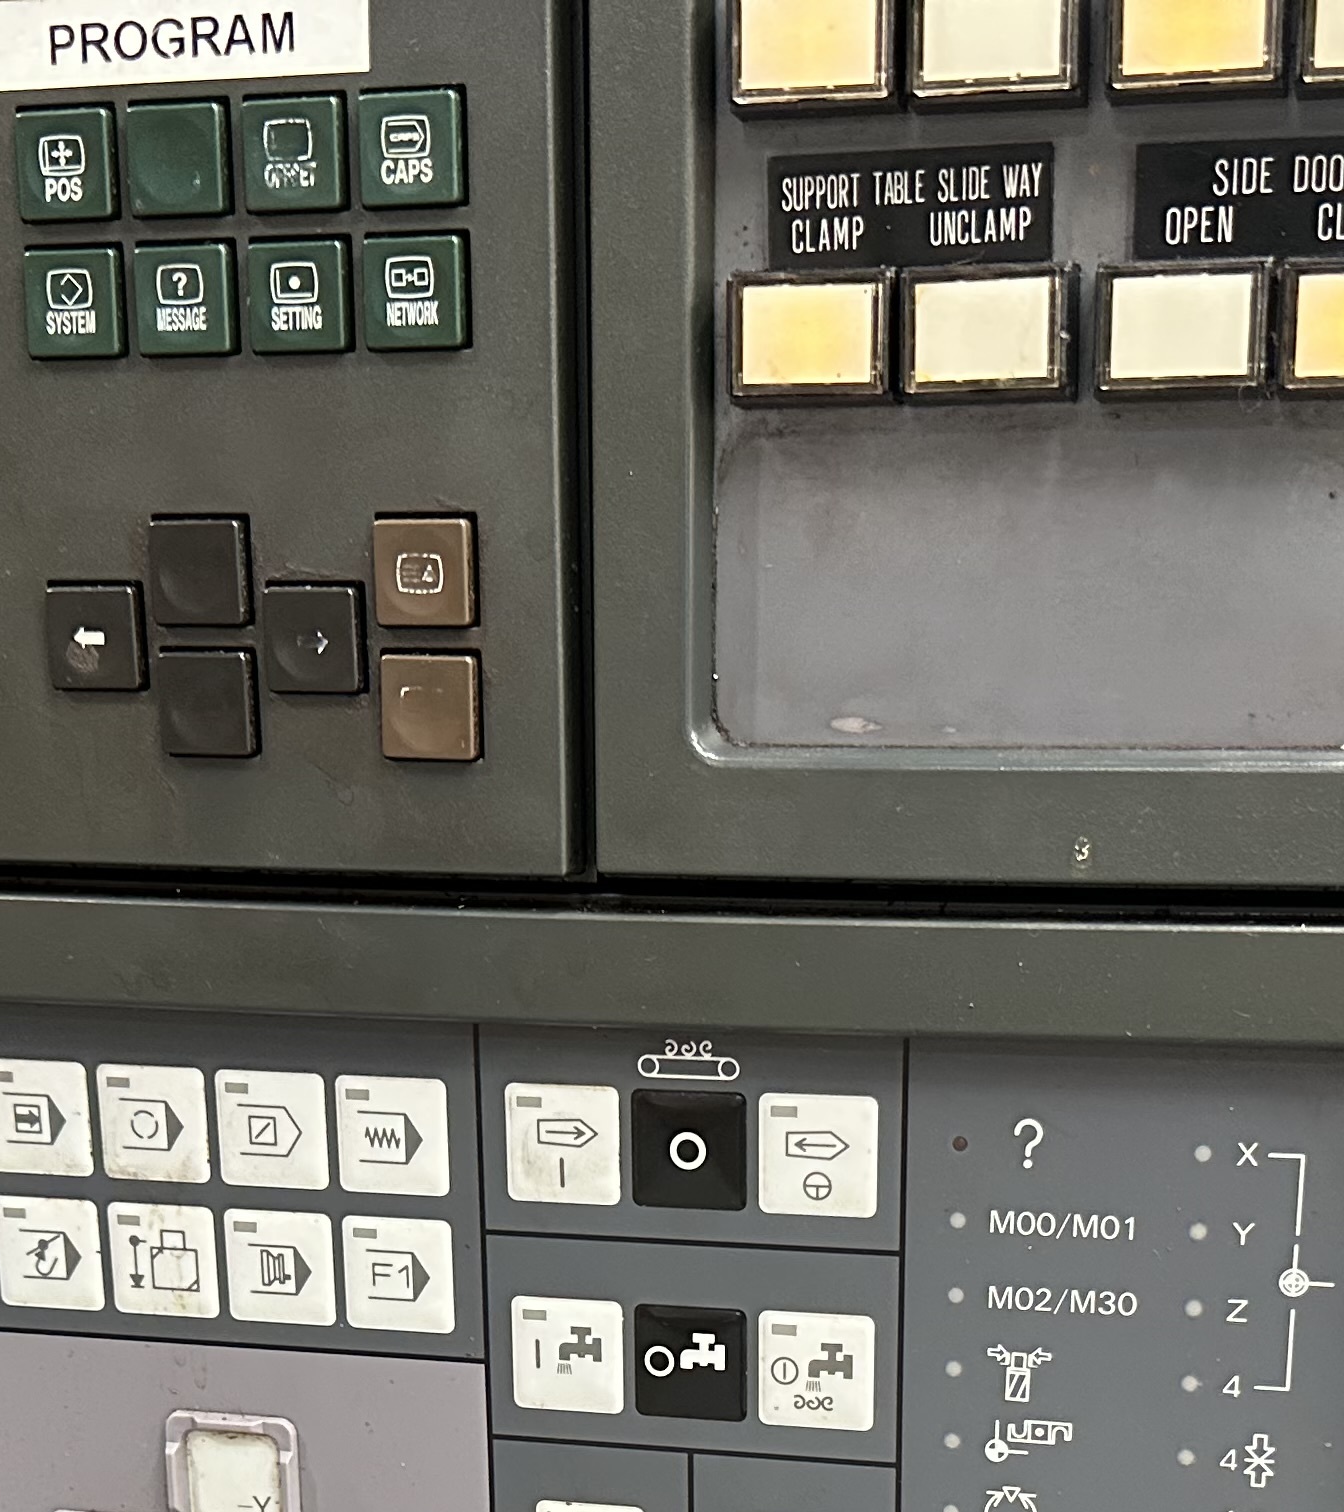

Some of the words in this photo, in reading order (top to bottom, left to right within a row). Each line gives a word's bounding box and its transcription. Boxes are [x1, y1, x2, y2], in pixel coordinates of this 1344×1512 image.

[49, 11, 295, 66] PROGRAM
[380, 156, 434, 185] CAPS
[1212, 156, 1275, 197] SIDE
[44, 176, 83, 203] POS
[781, 172, 861, 212] SUPPORT
[872, 169, 926, 206] TABLE
[937, 165, 991, 203] SLIDE
[1002, 162, 1043, 199] WAY
[791, 215, 864, 254] CLAMP
[929, 205, 1032, 247] UNCLAMP
[1165, 205, 1234, 246] OPEN
[45, 309, 96, 336] SYSTEM
[156, 305, 207, 332] MESSAGE
[271, 304, 323, 332] SETTING
[386, 300, 439, 327] NETWORK
[1236, 1142, 1259, 1167] X
[989, 1209, 1135, 1241] M00/M01
[1232, 1221, 1256, 1246] Y
[371, 1262, 410, 1289] F1
[987, 1285, 1138, 1317] M02/M30
[1225, 1298, 1249, 1323] Z
[1222, 1375, 1241, 1398] 4
[1219, 1448, 1238, 1471] 4
